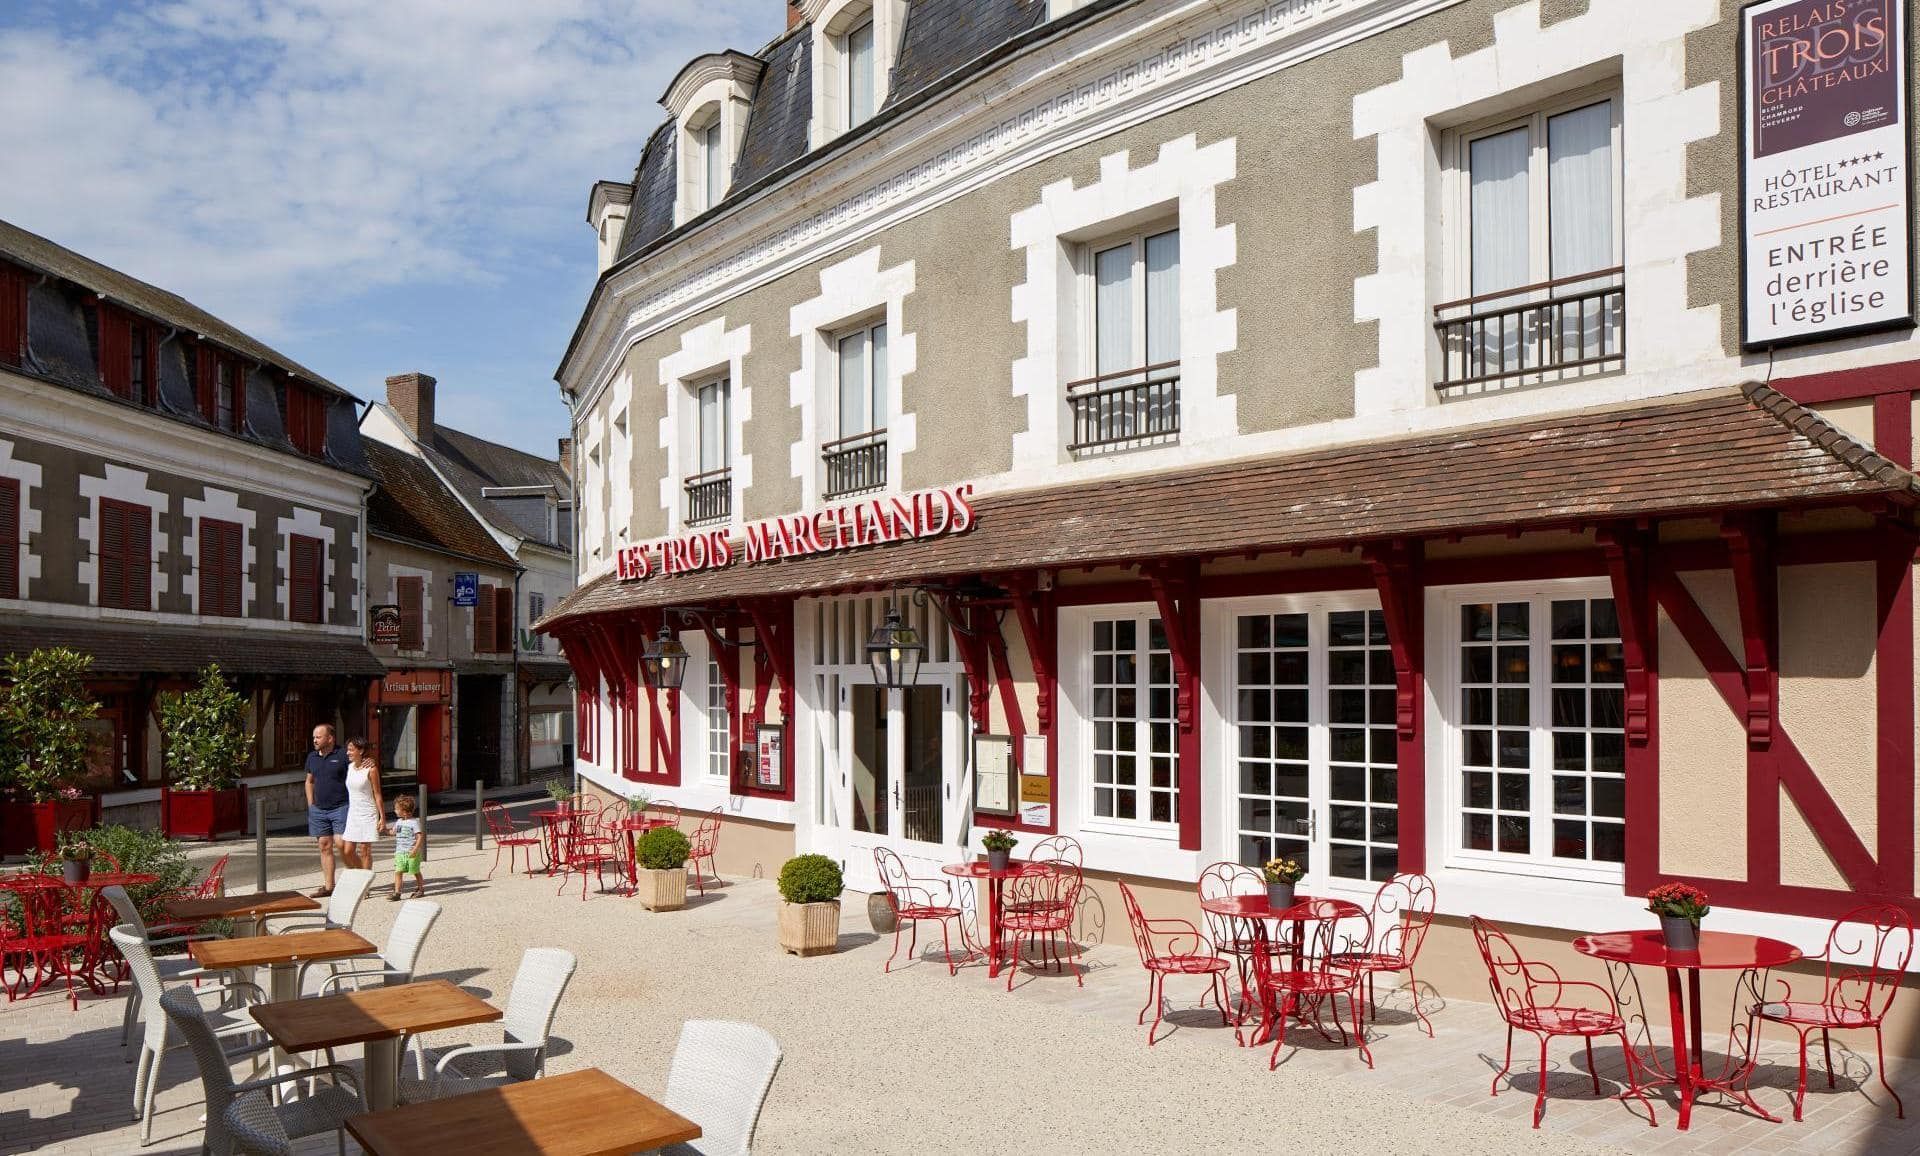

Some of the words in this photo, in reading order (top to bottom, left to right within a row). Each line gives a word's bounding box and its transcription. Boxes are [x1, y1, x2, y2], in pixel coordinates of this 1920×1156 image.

[1762, 0, 1847, 40] RELAIS
[1762, 16, 1886, 75] TROIS
[1762, 59, 1884, 104] CHÂTEAUX
[1754, 166, 1898, 212] RESTAURANT
[1765, 164, 1837, 192] HÔTEL
[1769, 224, 1888, 267] ENTRÉE
[1766, 258, 1889, 297] derrière
[1772, 290, 1885, 326] l'église
[616, 542, 651, 582] LES
[656, 528, 735, 576] TROIS
[743, 483, 976, 564] MARCHANDS
